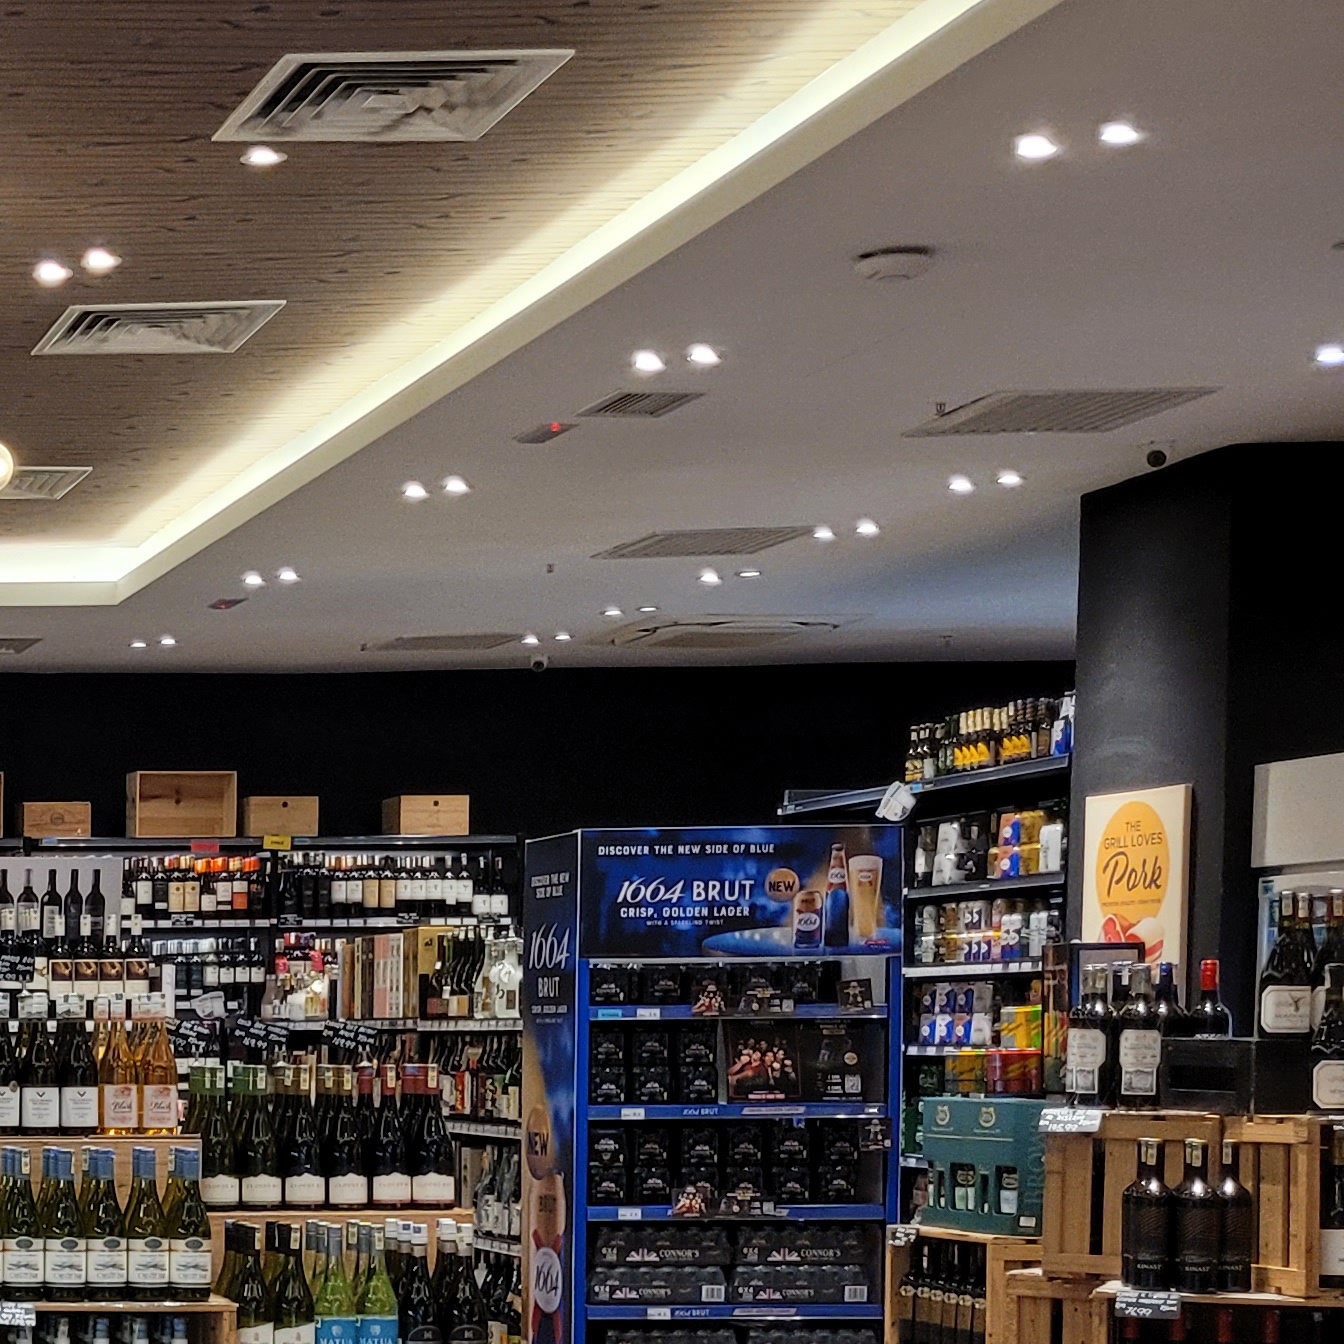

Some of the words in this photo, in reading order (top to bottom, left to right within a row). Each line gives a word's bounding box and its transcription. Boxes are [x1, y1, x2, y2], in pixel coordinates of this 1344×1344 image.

[1125, 821, 1141, 832] THE
[598, 846, 649, 855] DISCOVER
[654, 845, 673, 854] THE
[678, 845, 701, 854] NEW
[706, 845, 728, 854] SIDE
[733, 844, 746, 853] OF
[750, 843, 775, 853] BLUE
[1104, 836, 1128, 849] GRILL
[1131, 832, 1162, 847] LOVES
[1103, 851, 1162, 898] Pork
[617, 877, 686, 903] 1664
[693, 880, 754, 901] BRUT
[768, 879, 796, 892] NEW
[663, 907, 708, 917] GOLDEN
[714, 906, 750, 917] LAGER
[529, 923, 570, 969] 1664
[538, 976, 560, 998] BRUT
[528, 1131, 549, 1157] NEW
